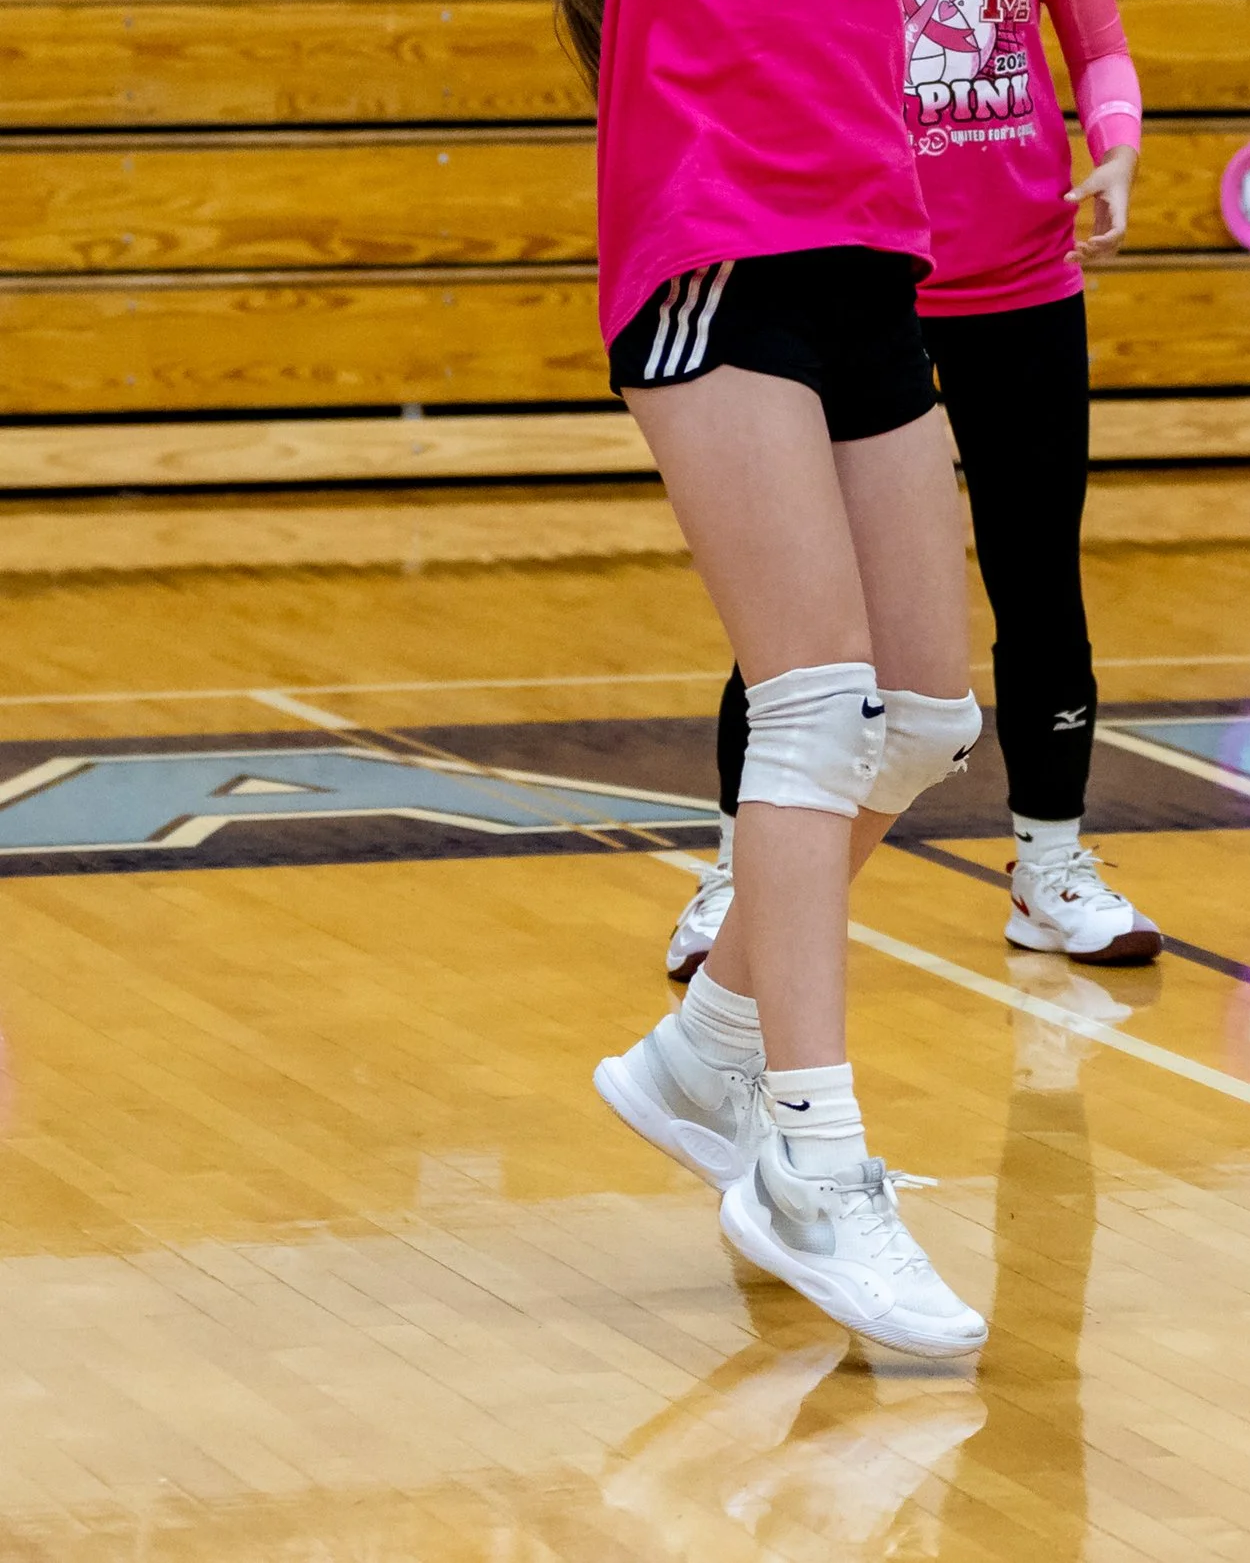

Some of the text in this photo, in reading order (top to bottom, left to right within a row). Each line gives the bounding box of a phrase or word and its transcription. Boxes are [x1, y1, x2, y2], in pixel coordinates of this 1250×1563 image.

[915, 70, 1034, 126] PINK
[950, 129, 985, 143] UNITED
[988, 126, 1007, 141] FOR
